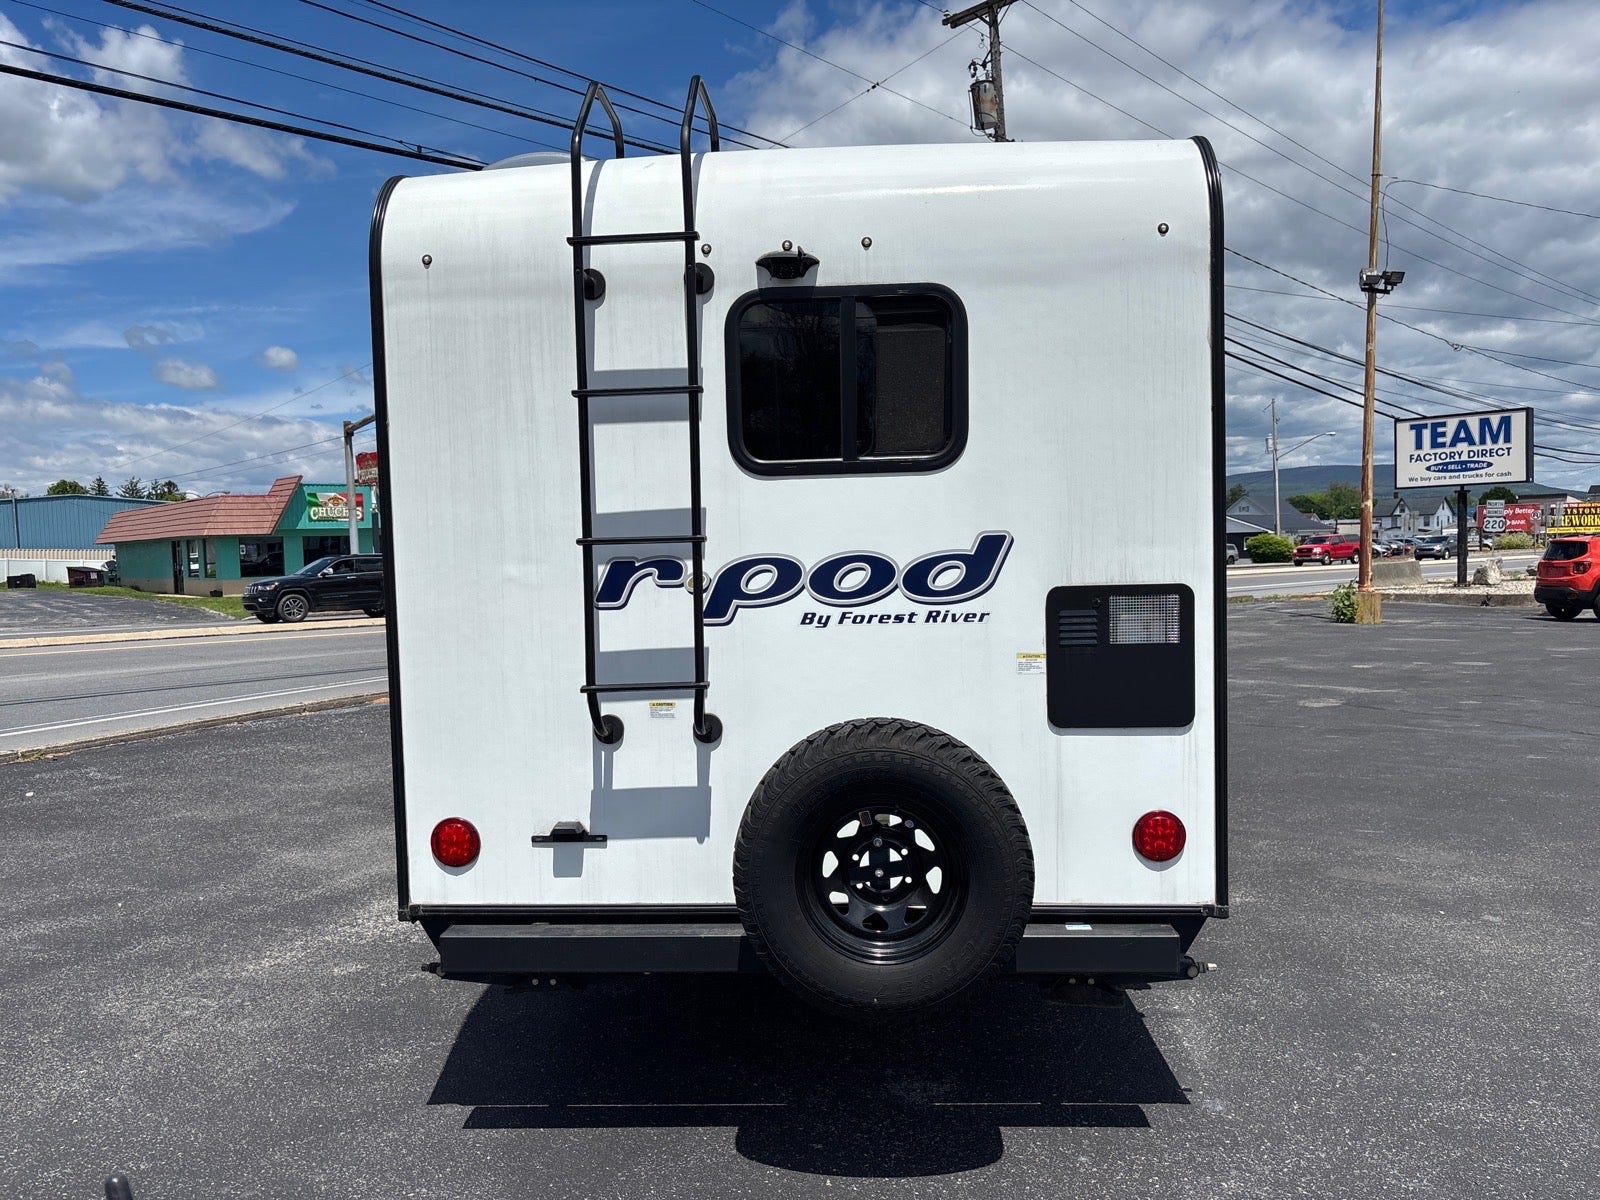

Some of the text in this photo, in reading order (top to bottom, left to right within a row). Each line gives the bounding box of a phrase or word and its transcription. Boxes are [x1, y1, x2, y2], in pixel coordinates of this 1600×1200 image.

[1409, 415, 1512, 451] TEAM
[1409, 447, 1512, 463] FACTORY DIRECT
[1484, 519, 1505, 529] 220
[800, 610, 990, 628] By Forest River
